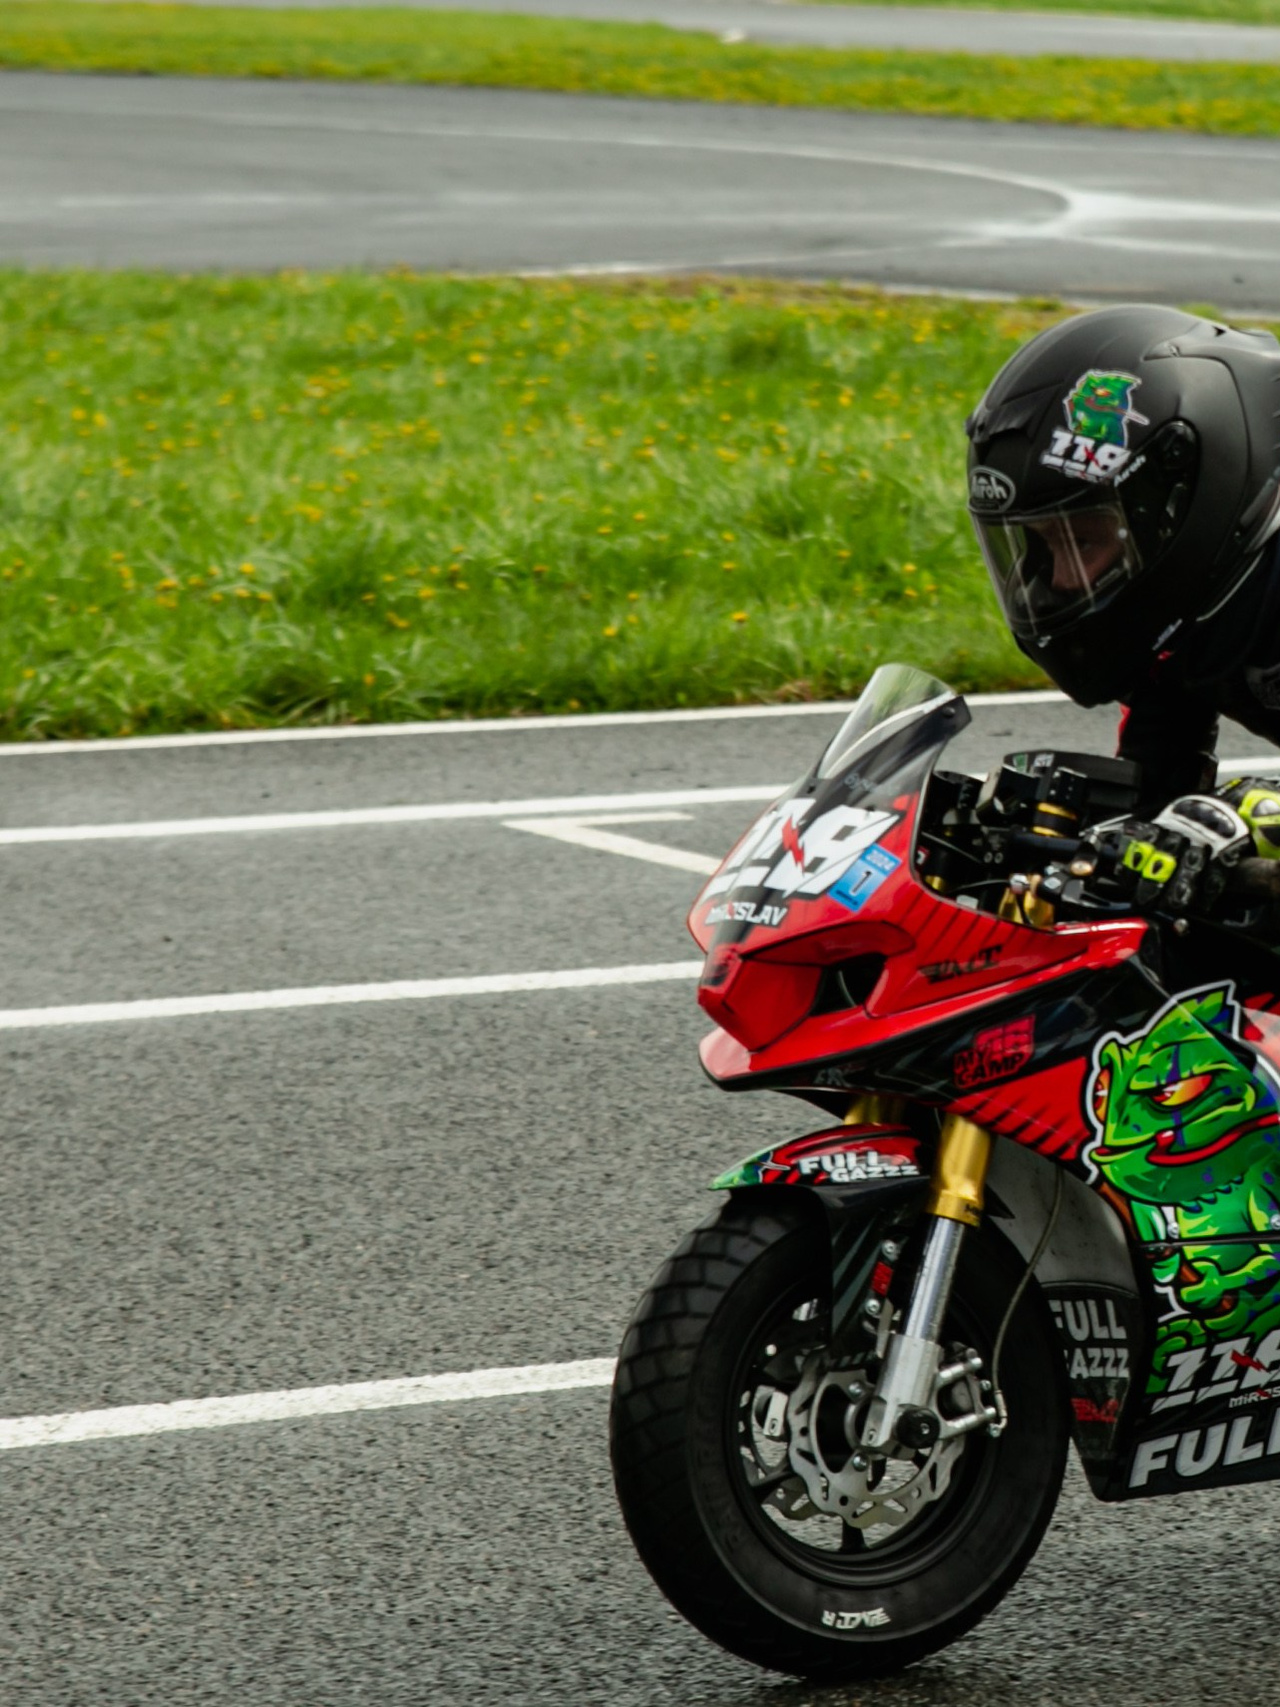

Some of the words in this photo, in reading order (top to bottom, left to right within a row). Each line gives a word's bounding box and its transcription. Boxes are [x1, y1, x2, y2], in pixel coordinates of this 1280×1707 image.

[955, 1052, 1026, 1087] CAMP
[800, 1150, 889, 1176] FULL
[830, 1164, 920, 1183] GAZZZ
[1063, 1347, 1130, 1379] AZZZ
